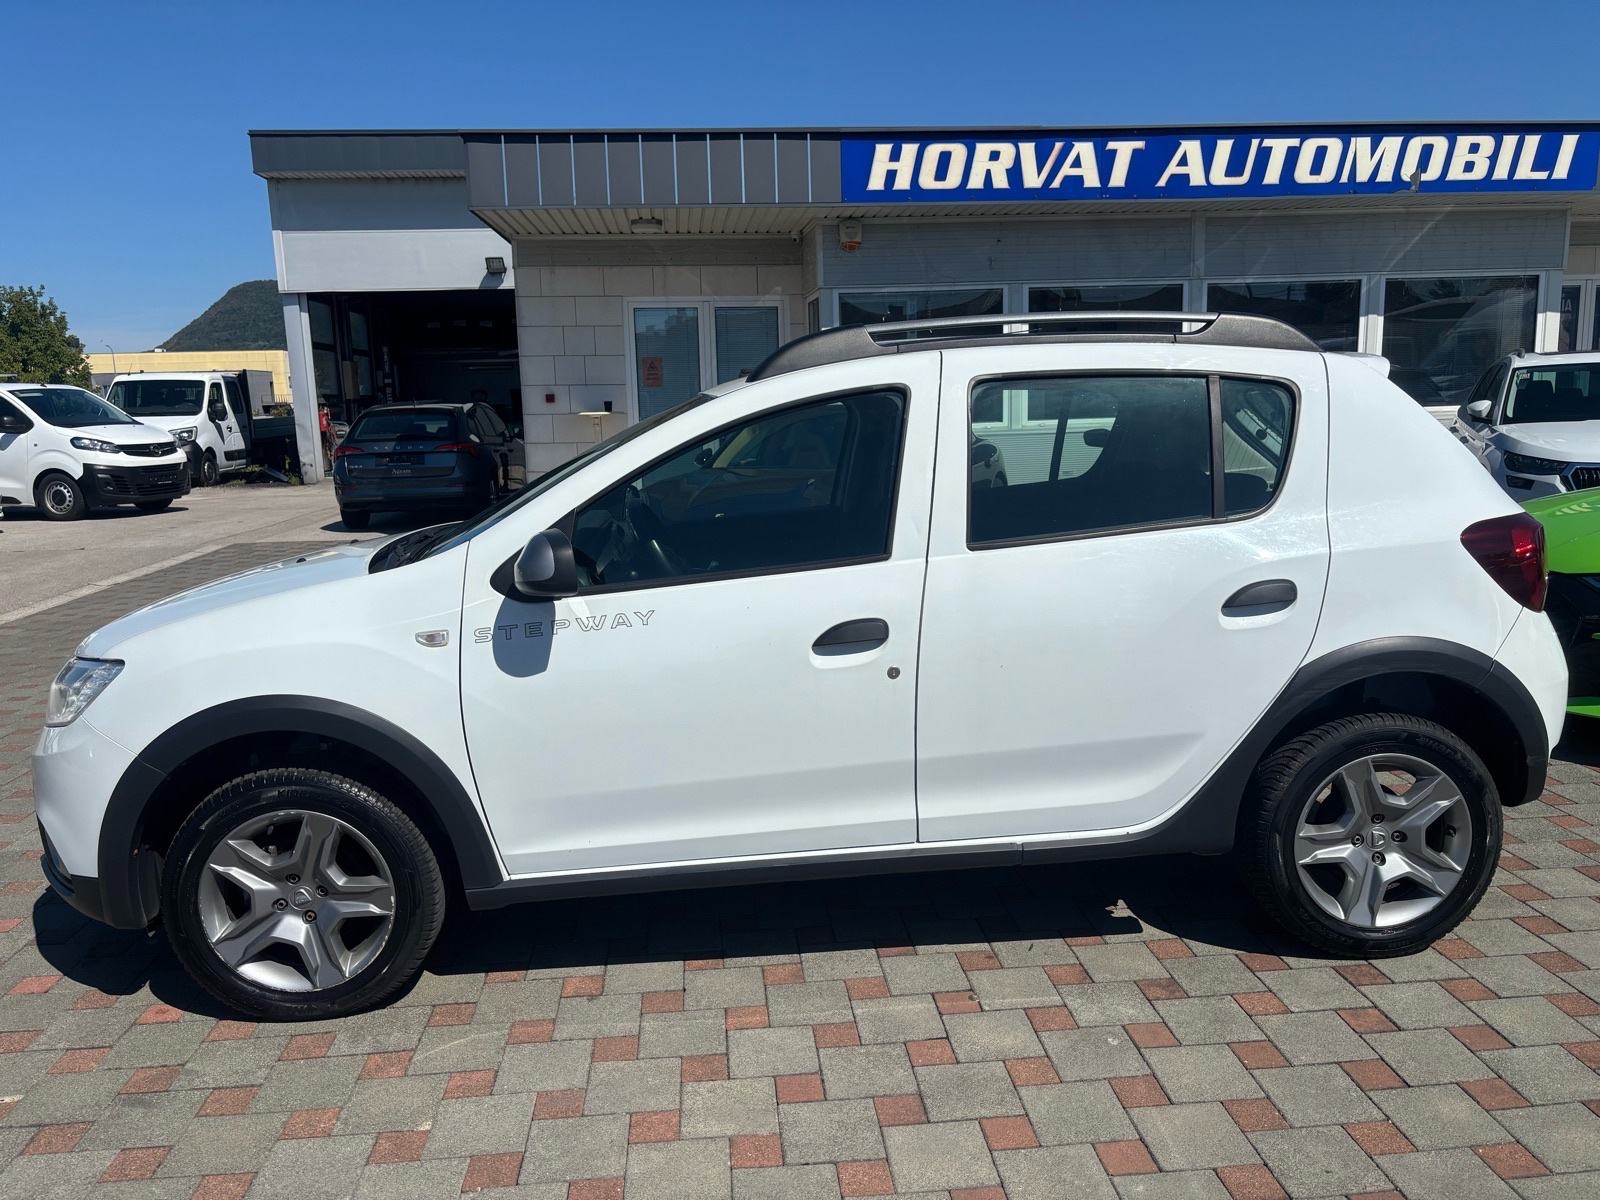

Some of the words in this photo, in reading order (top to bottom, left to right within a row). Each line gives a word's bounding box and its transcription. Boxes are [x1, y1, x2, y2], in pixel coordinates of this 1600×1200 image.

[866, 141, 1146, 191] HORVAT
[1155, 134, 1581, 188] AUTOMOBILI
[473, 609, 656, 644] STEPWAY
